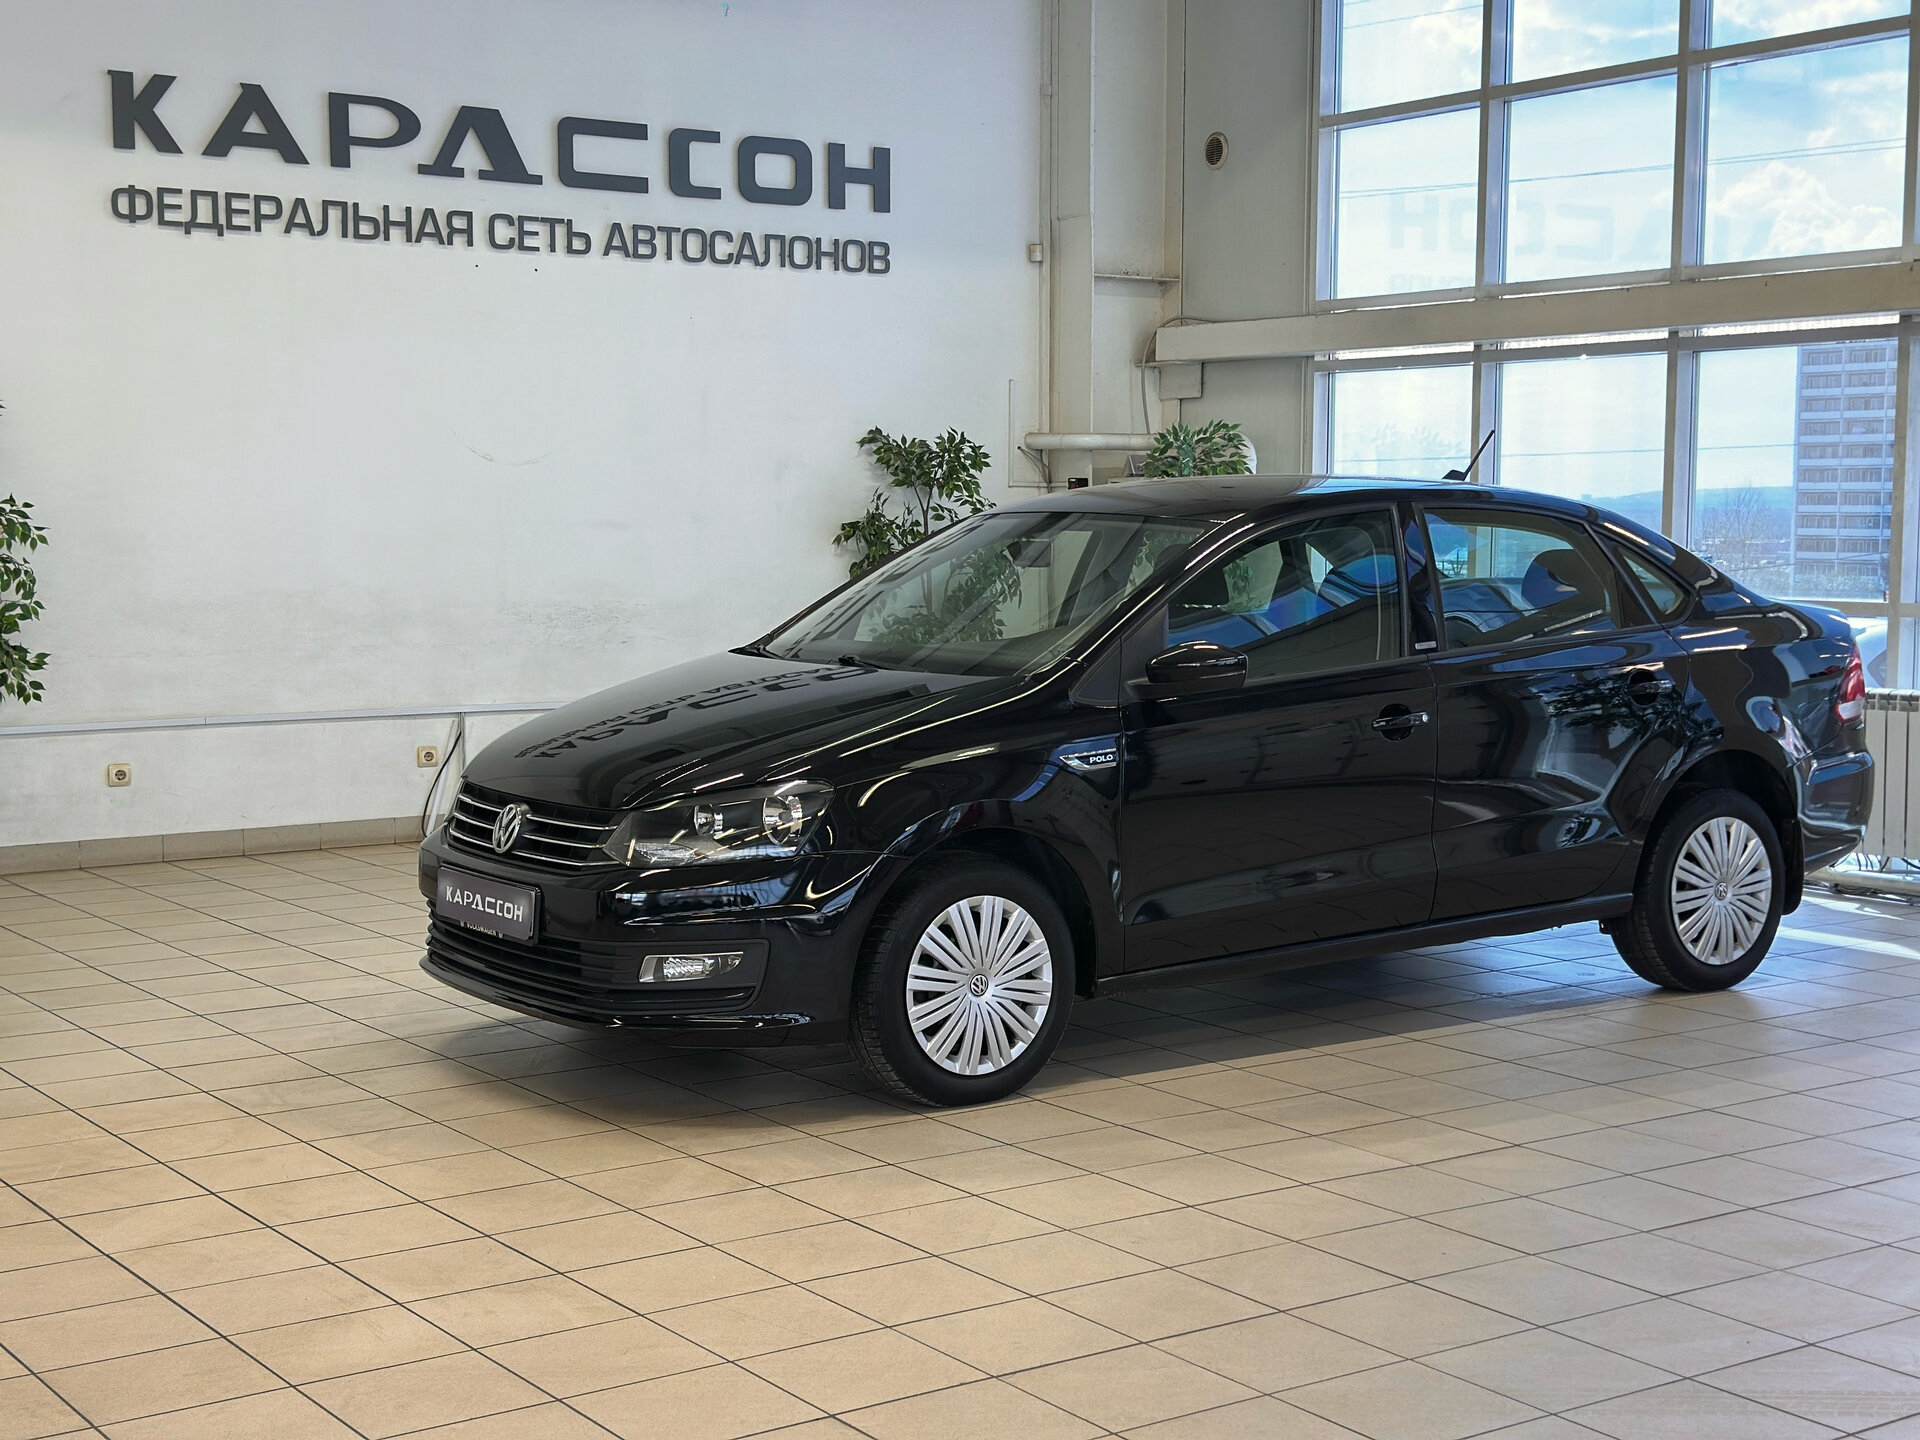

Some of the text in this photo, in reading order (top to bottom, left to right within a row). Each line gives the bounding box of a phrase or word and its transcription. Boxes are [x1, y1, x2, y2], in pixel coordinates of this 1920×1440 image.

[107, 70, 891, 214] КАРАССОН
[111, 185, 891, 274] ФЕДЕРАЛЬНАЯ СЕТЬ АВТОСАЛОНОВ
[1089, 754, 1114, 764] POLO
[446, 885, 523, 922] КАРАССОН
